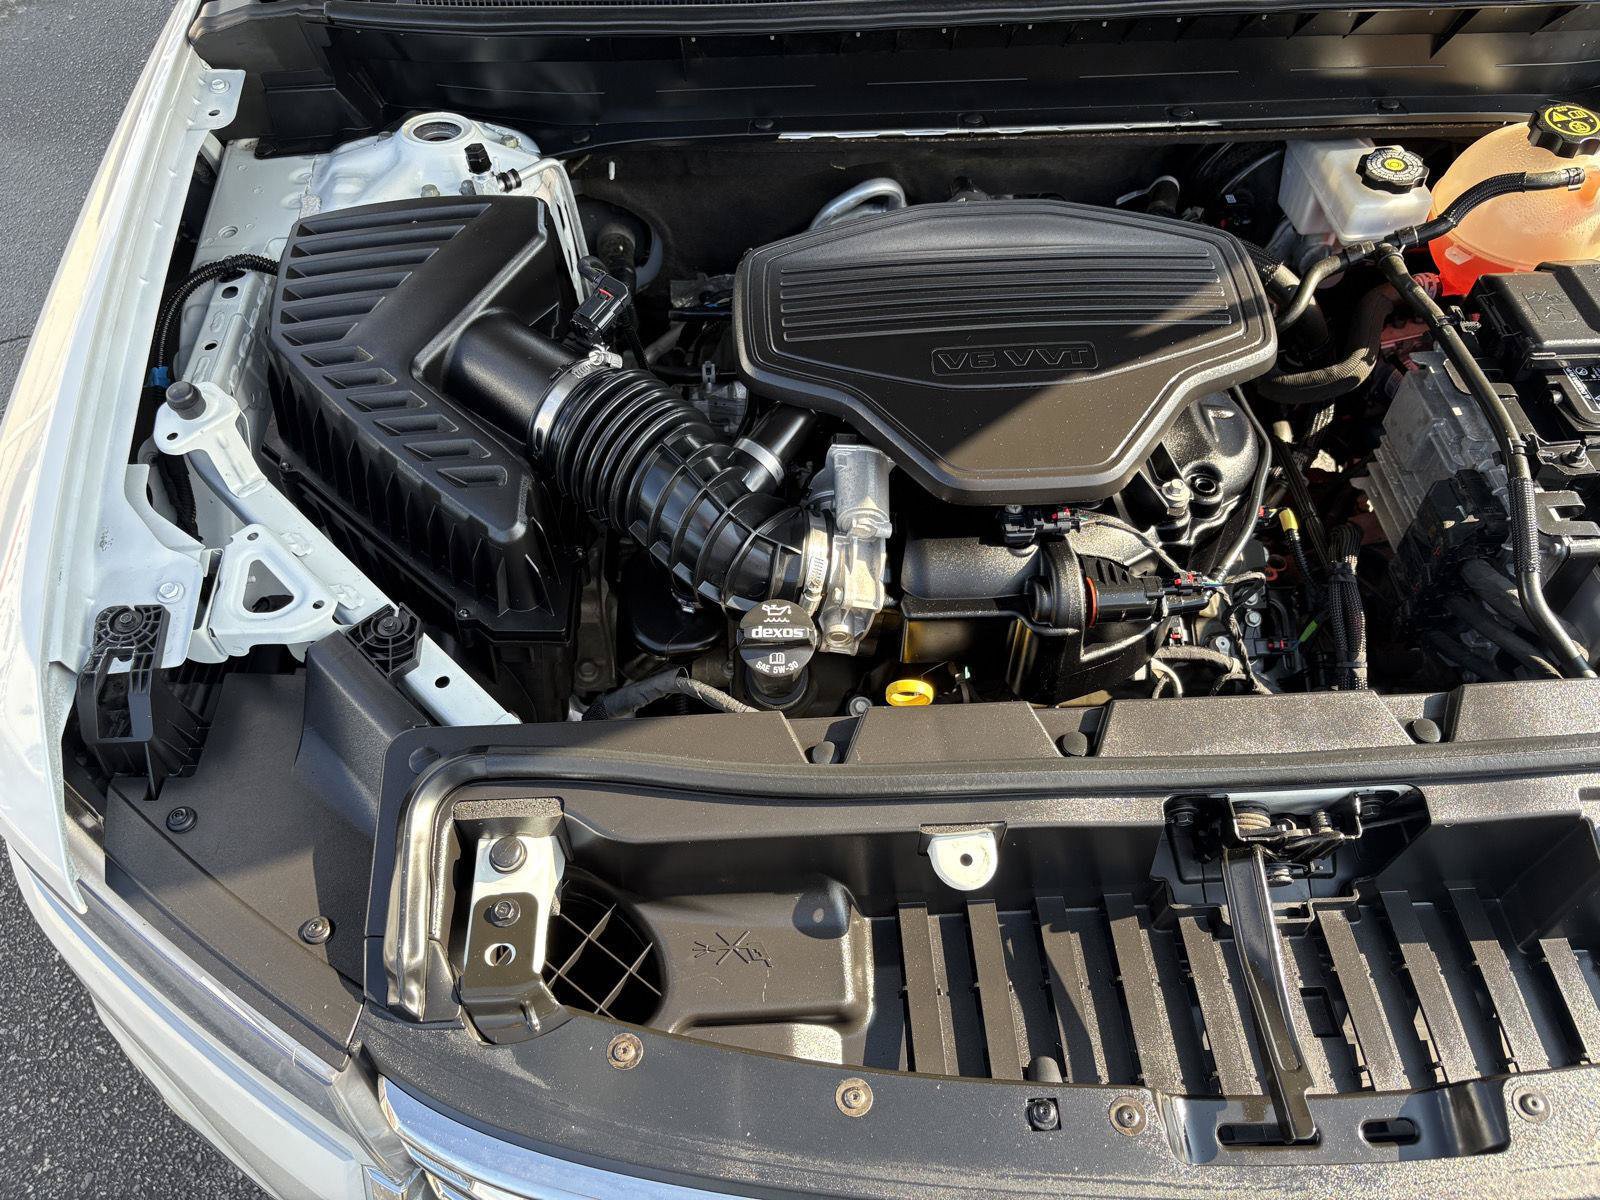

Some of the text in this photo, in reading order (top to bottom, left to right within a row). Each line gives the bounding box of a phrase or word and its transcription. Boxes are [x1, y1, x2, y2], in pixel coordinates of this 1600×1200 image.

[937, 347, 1088, 370] V6 VVT
[751, 626, 804, 638] dexos
[755, 660, 799, 674] SAE 5W-30
